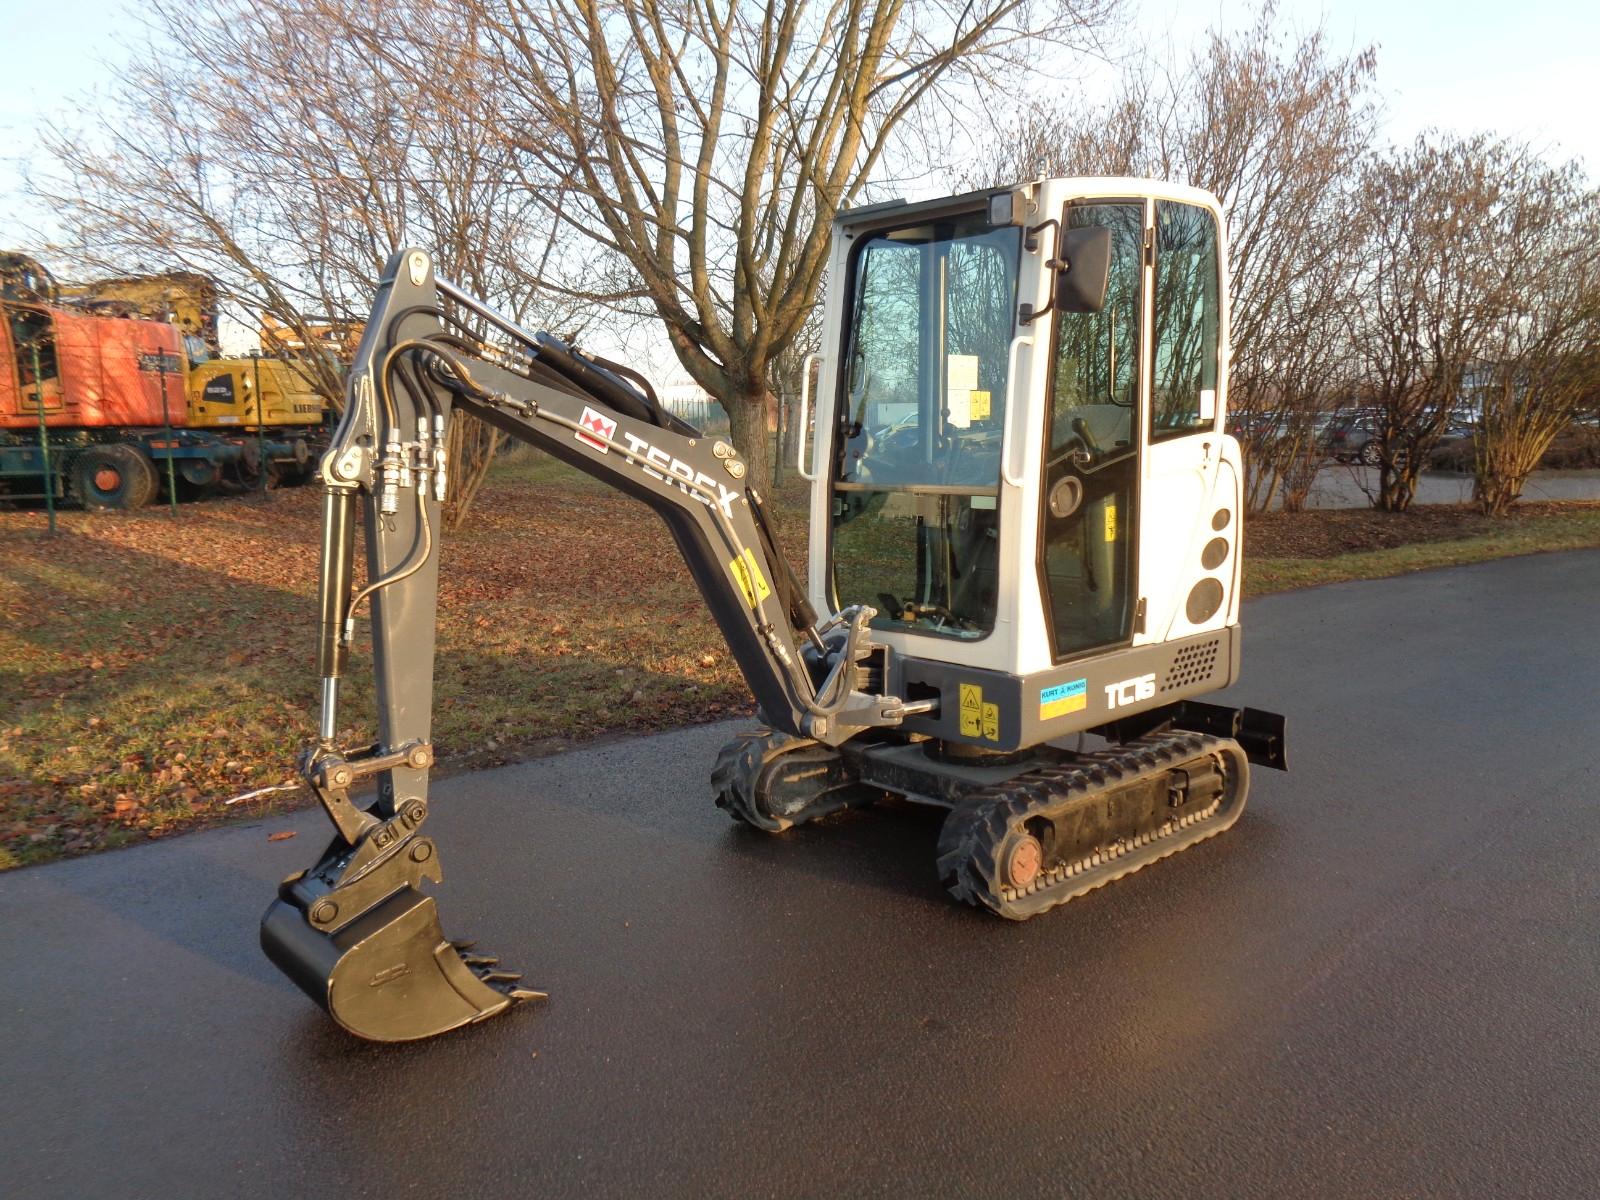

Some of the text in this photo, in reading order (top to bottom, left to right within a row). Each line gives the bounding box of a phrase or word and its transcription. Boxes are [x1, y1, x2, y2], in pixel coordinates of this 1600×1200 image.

[625, 432, 740, 519] TEREX
[1041, 689, 1059, 699] KURT
[1104, 672, 1156, 709] TC16
